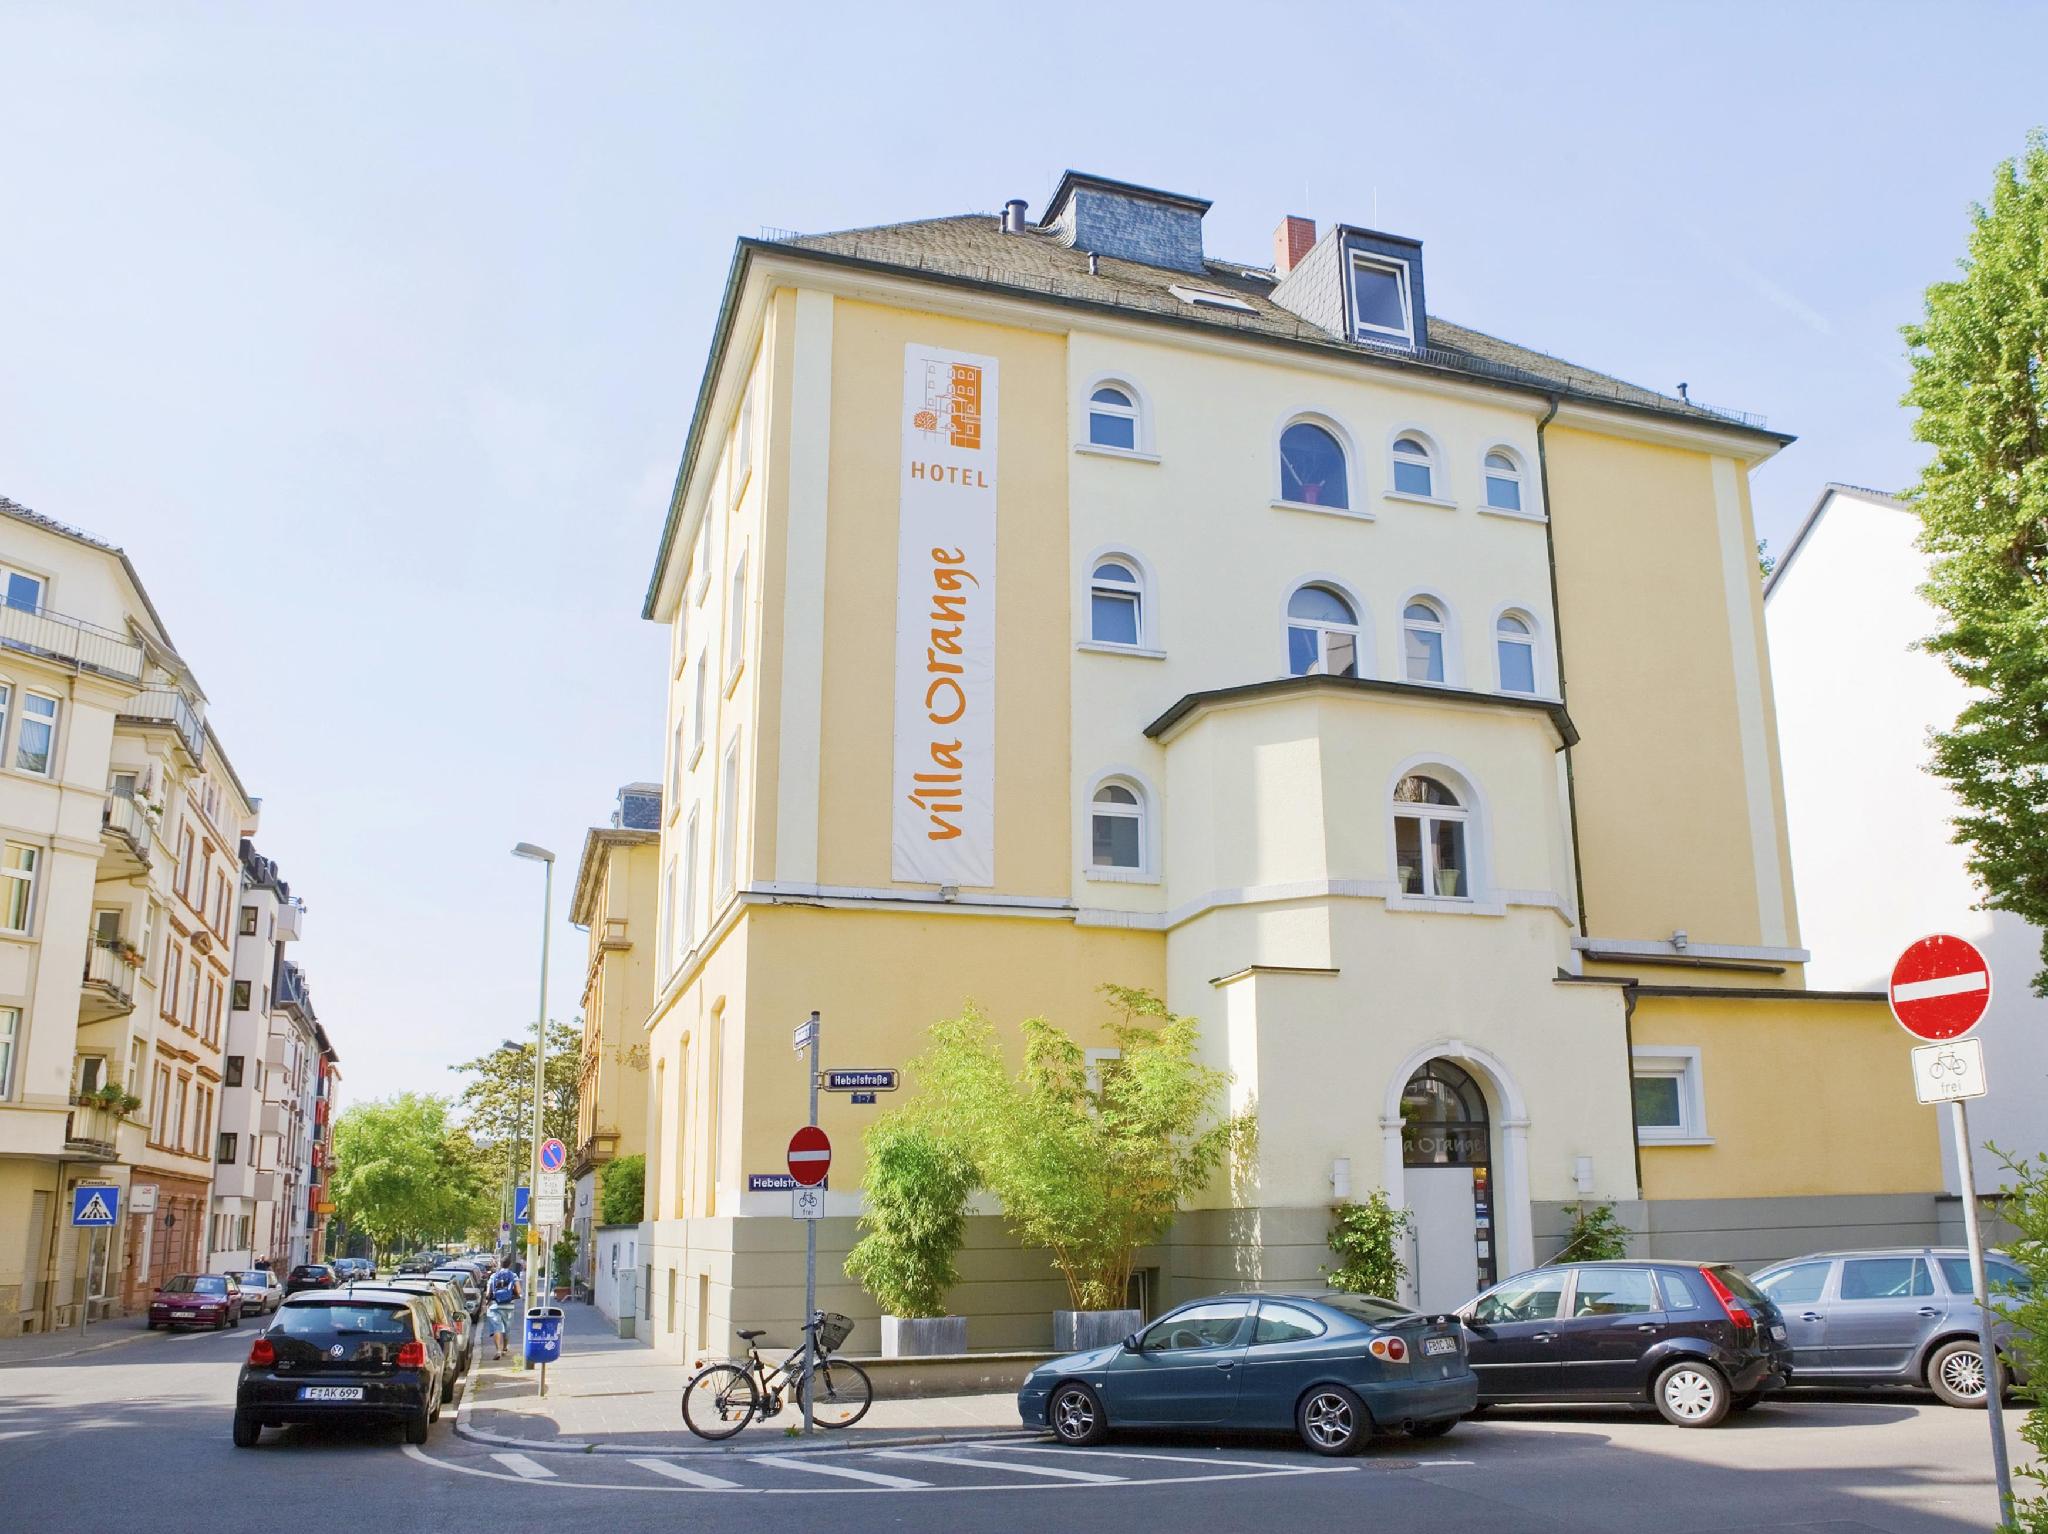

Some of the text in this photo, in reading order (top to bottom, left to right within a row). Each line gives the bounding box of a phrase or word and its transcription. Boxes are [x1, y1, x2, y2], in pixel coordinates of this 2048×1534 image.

[911, 461, 989, 488] HOTEL
[925, 547, 980, 724] Orange
[834, 1074, 888, 1086] Hebelstraße
[1940, 1079, 1962, 1094] frei
[1418, 1136, 1481, 1158] Orange
[802, 1208, 814, 1217] frei
[323, 1388, 337, 1398] AK
[339, 1388, 359, 1398] 699
